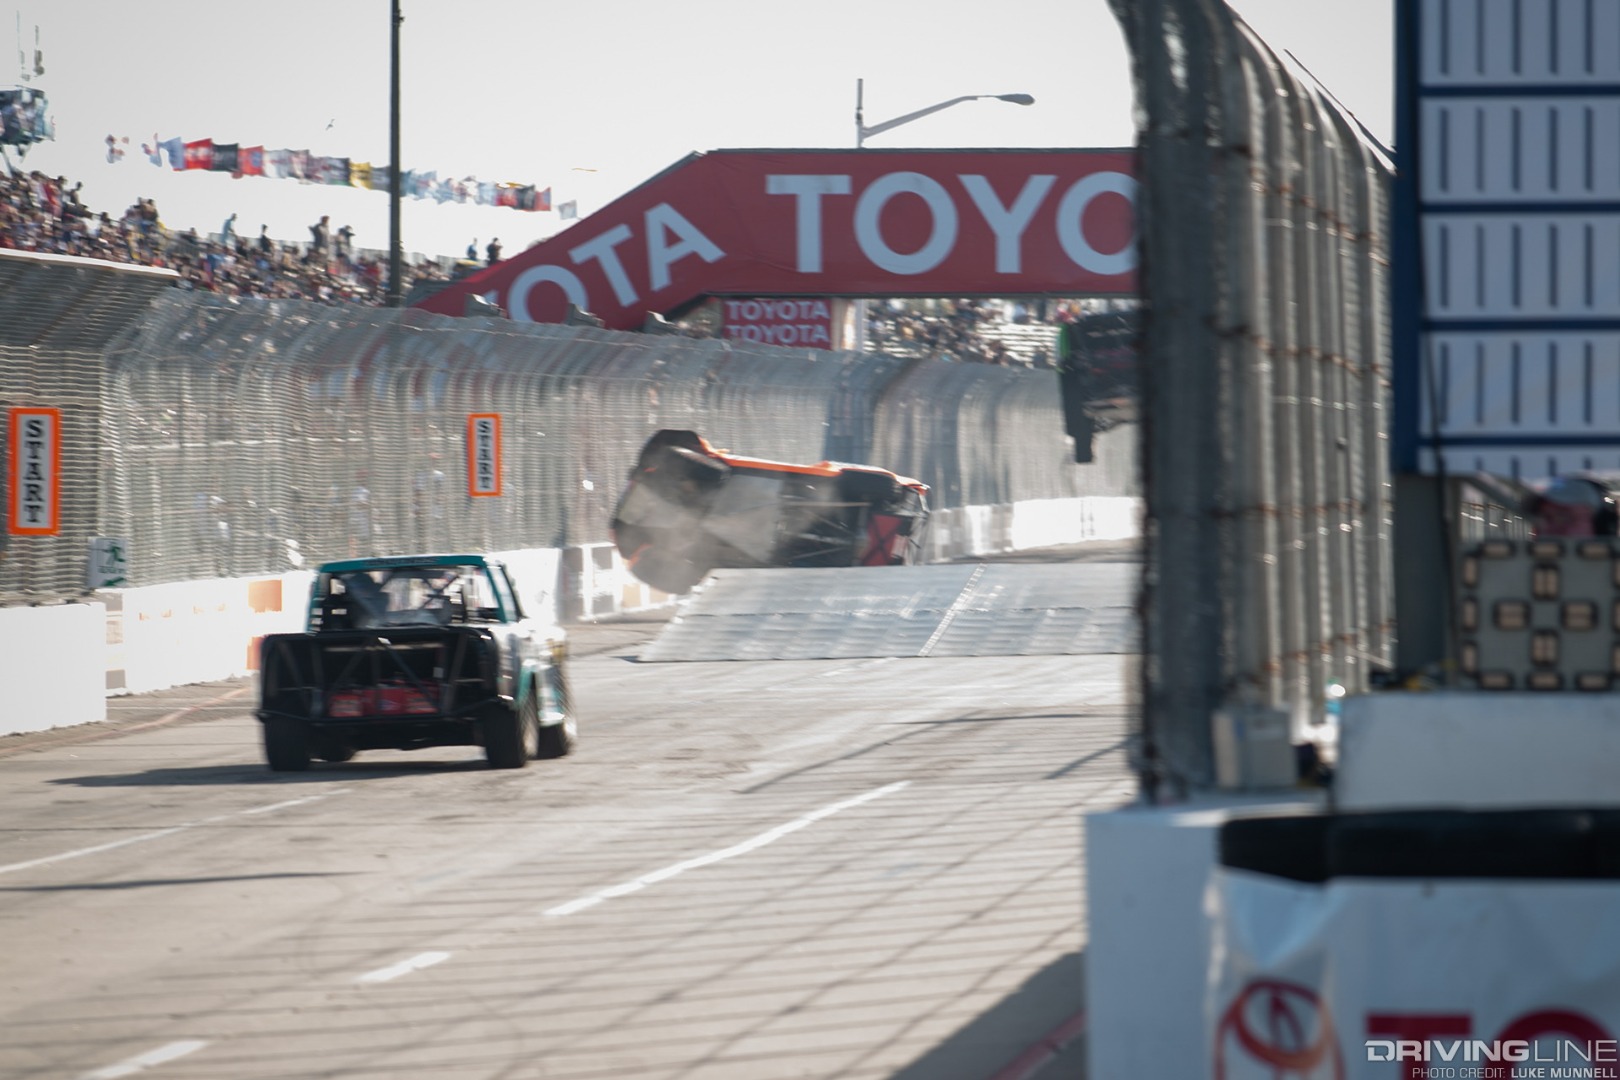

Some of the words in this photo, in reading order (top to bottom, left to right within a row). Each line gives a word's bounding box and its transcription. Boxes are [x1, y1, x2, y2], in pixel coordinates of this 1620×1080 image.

[483, 202, 727, 325] OTA
[725, 300, 831, 320] TOYOTA
[725, 324, 831, 343] TOYOTA
[24, 419, 45, 523] START
[478, 420, 493, 489] START
